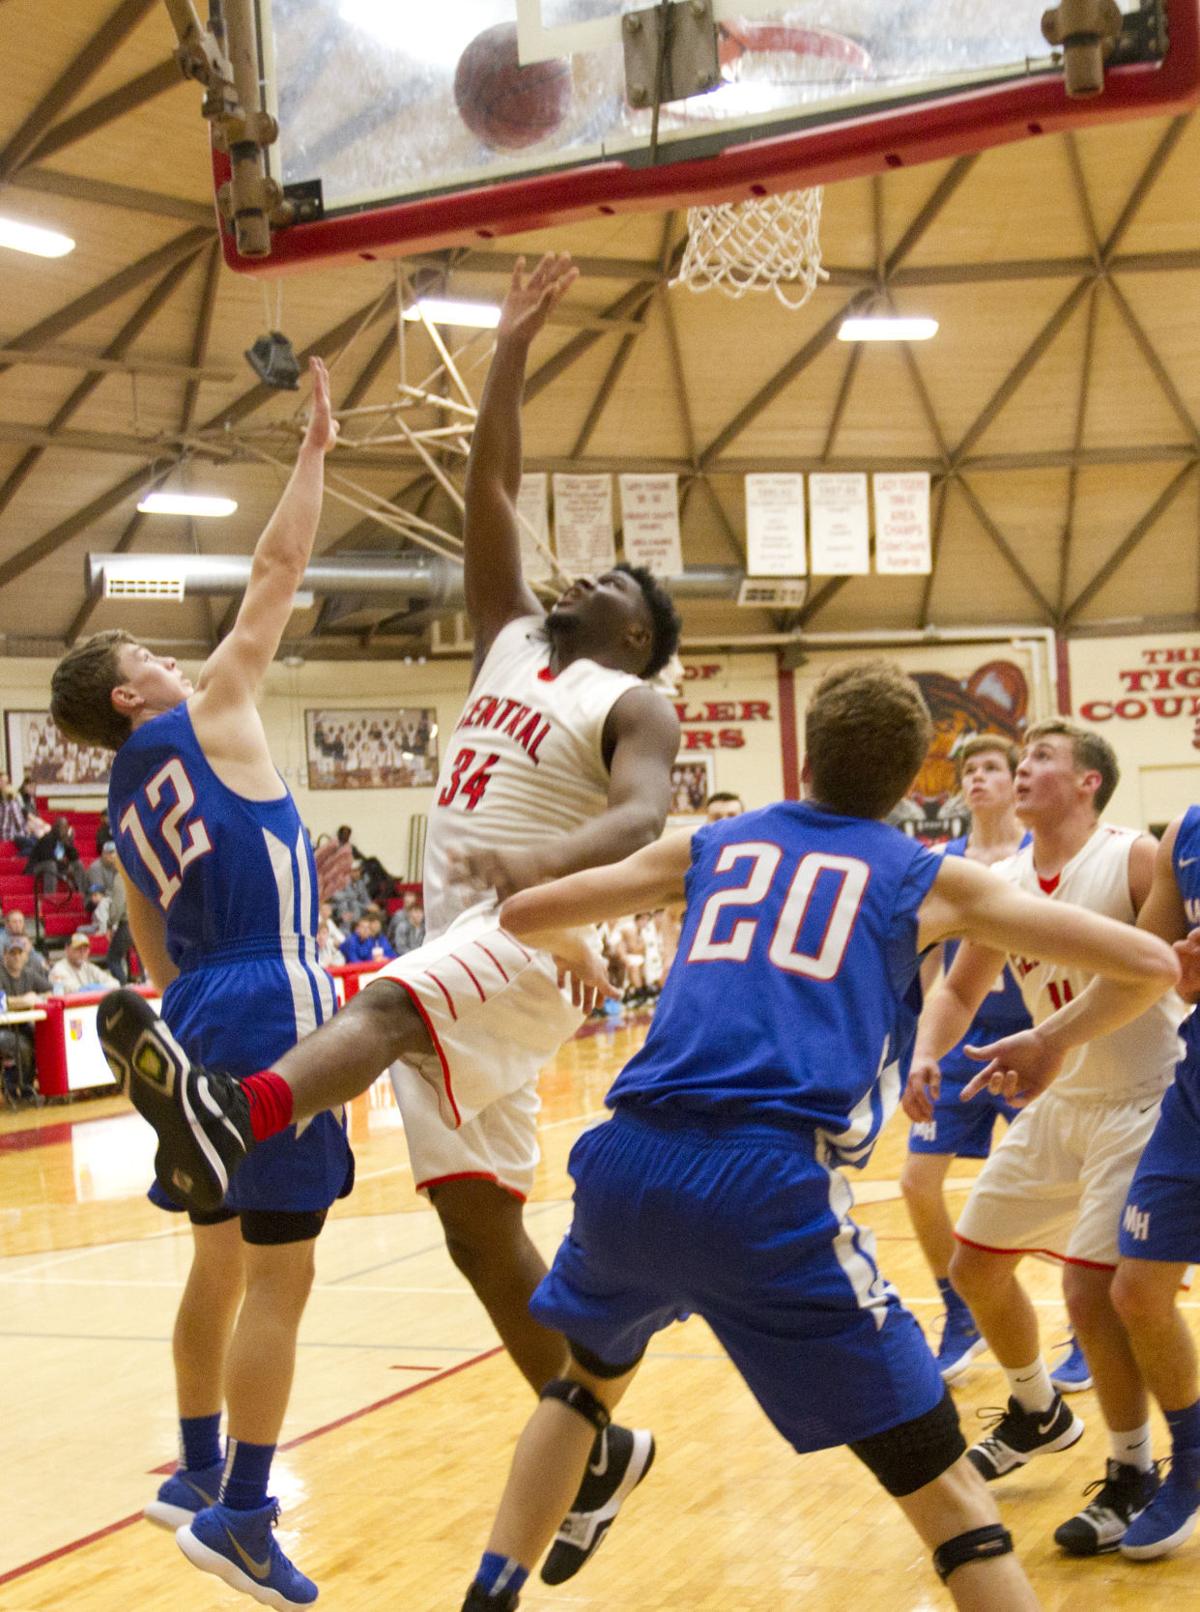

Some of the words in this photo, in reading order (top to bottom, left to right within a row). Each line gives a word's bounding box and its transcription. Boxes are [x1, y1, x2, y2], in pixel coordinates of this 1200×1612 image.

[457, 694, 551, 767] ENTRAL
[438, 747, 500, 812] 34
[119, 757, 212, 912] 12
[687, 840, 872, 984] 20
[1122, 1204, 1151, 1241] MH
